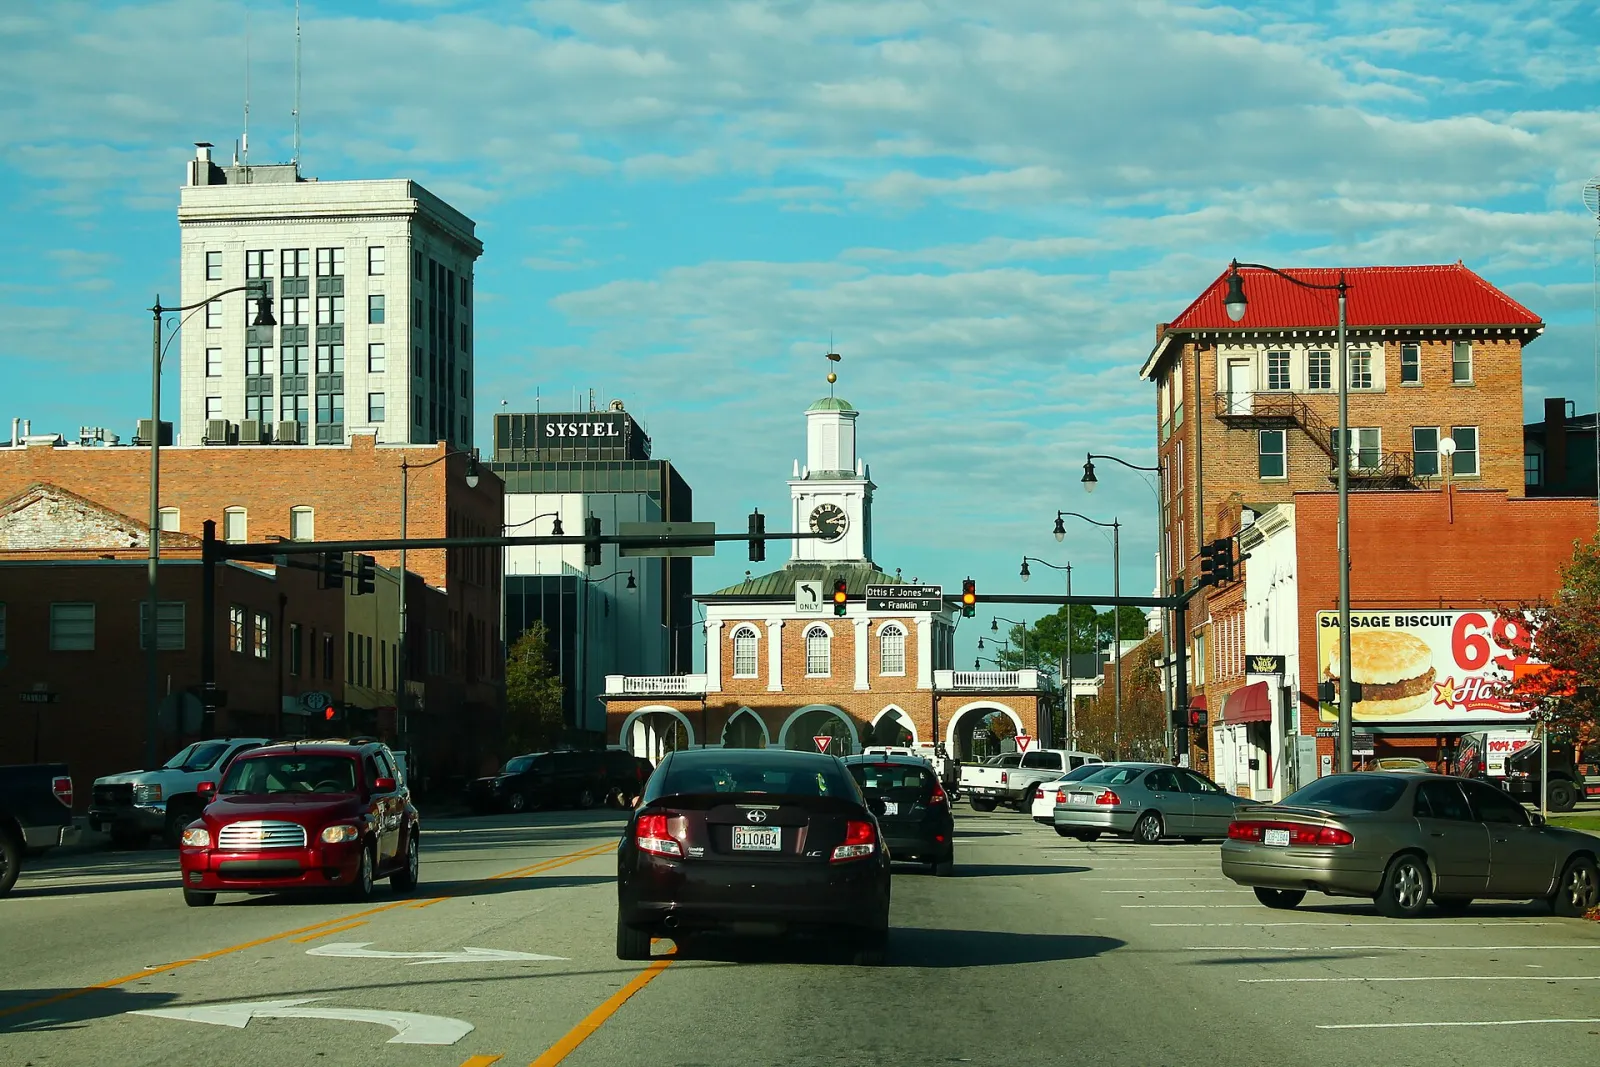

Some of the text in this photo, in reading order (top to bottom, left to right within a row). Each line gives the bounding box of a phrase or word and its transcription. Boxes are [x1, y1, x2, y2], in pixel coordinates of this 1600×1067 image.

[545, 422, 619, 437] SYSTEL
[867, 588, 888, 597] Ottis
[889, 588, 895, 597] F.
[897, 588, 922, 597] Jones
[888, 601, 918, 609] Franklin
[1320, 615, 1454, 628] SASAGE BISCUIT
[735, 832, 777, 846] 8110AB4
